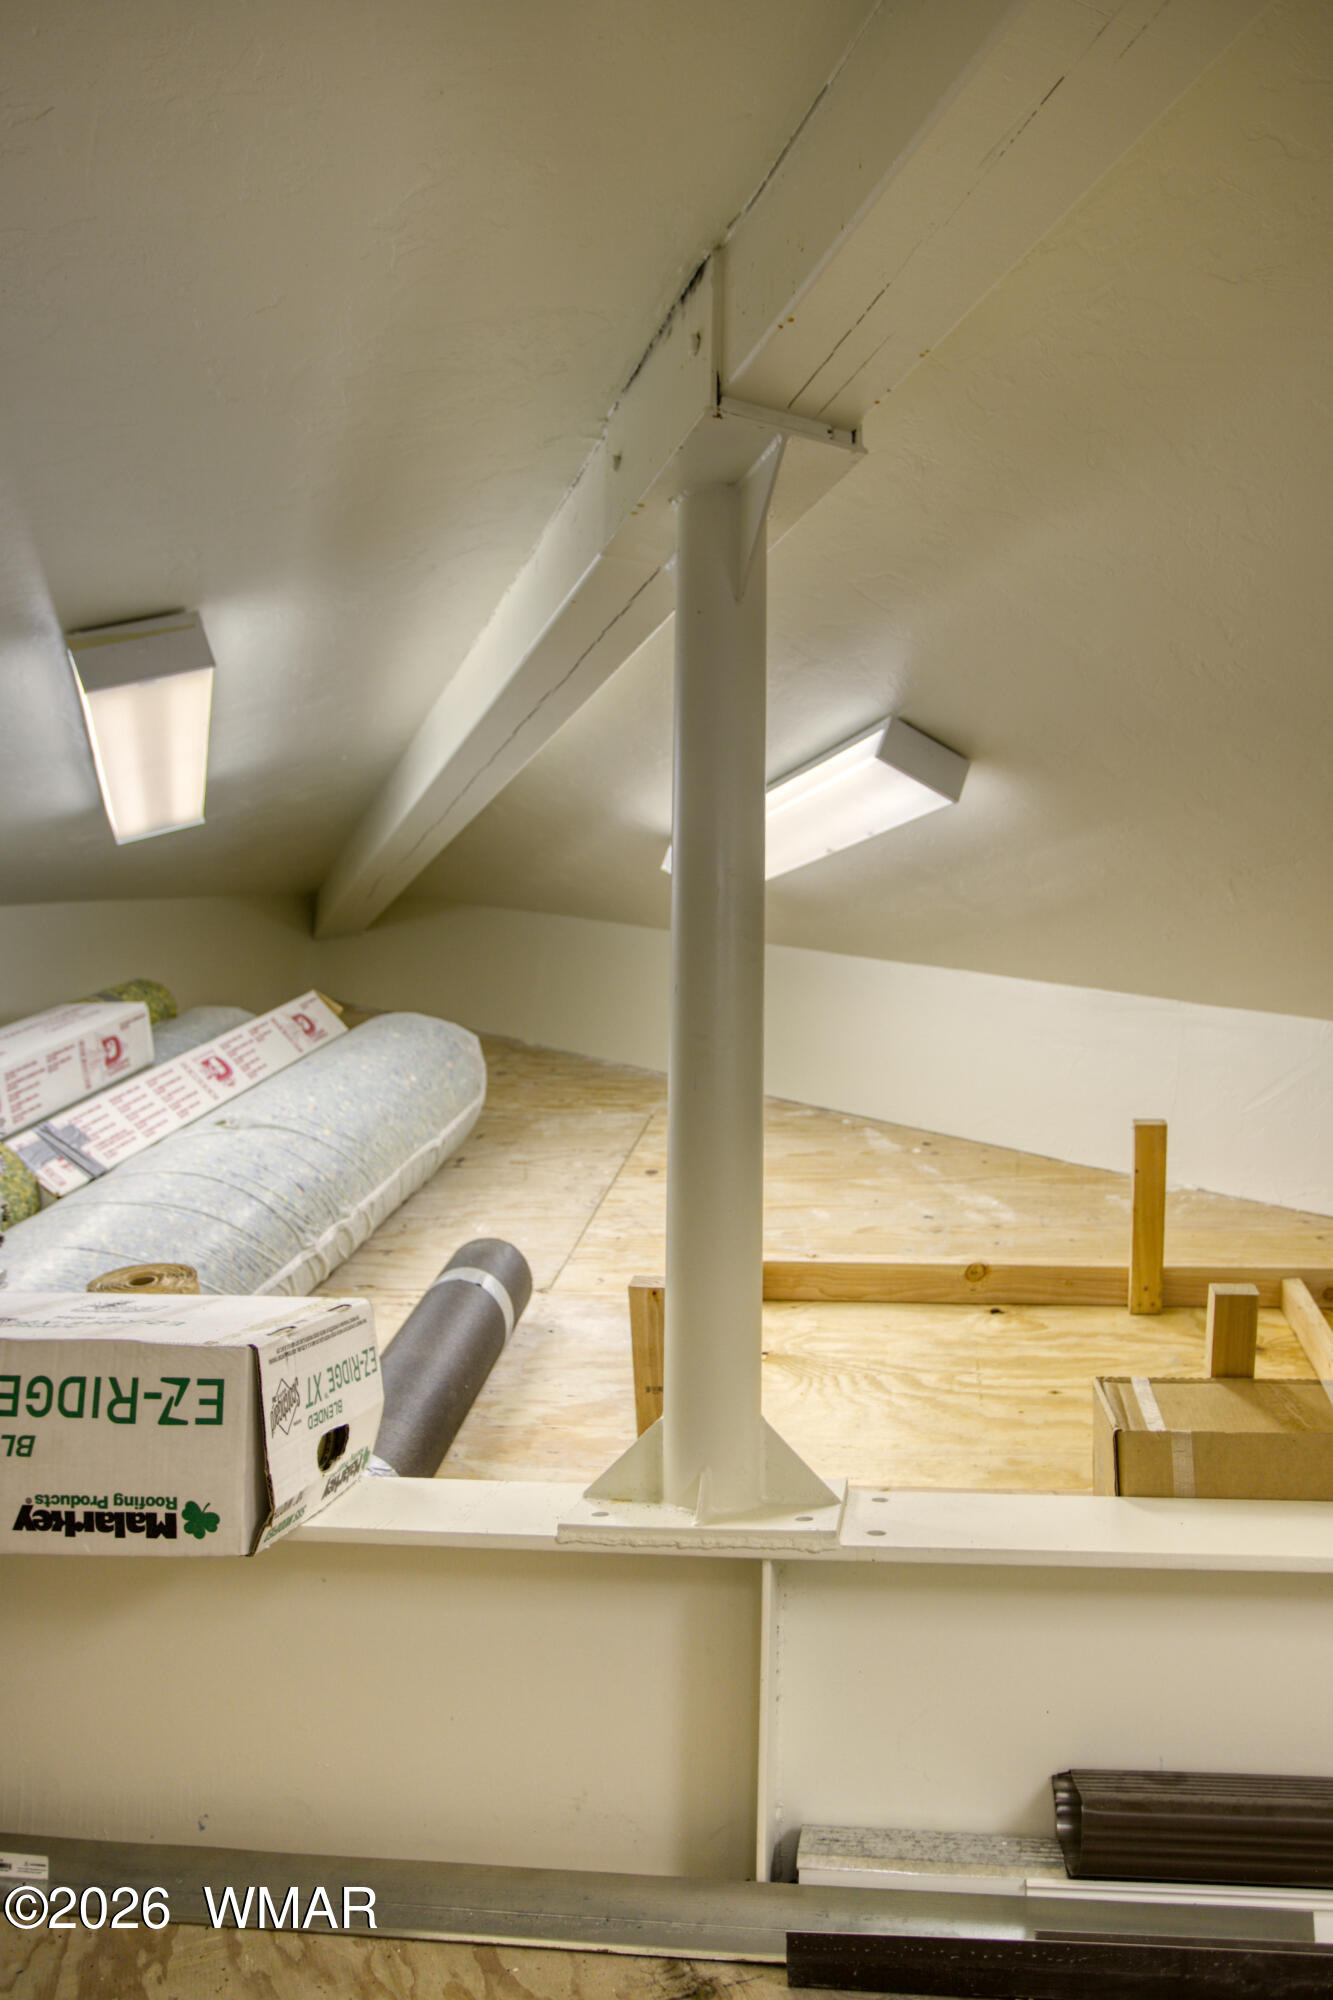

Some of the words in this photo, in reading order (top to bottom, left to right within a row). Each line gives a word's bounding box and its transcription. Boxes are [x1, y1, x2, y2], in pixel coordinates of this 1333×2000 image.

[327, 1345, 378, 1394] EZ-RIDGE
[0, 1375, 225, 1426] EZ-RIDGE
[304, 1370, 323, 1409] XT
[306, 1399, 343, 1431] BLENDED
[0, 1434, 36, 1458] BL
[114, 1493, 178, 1511] Roofing
[12, 1504, 178, 1540] Malarkey
